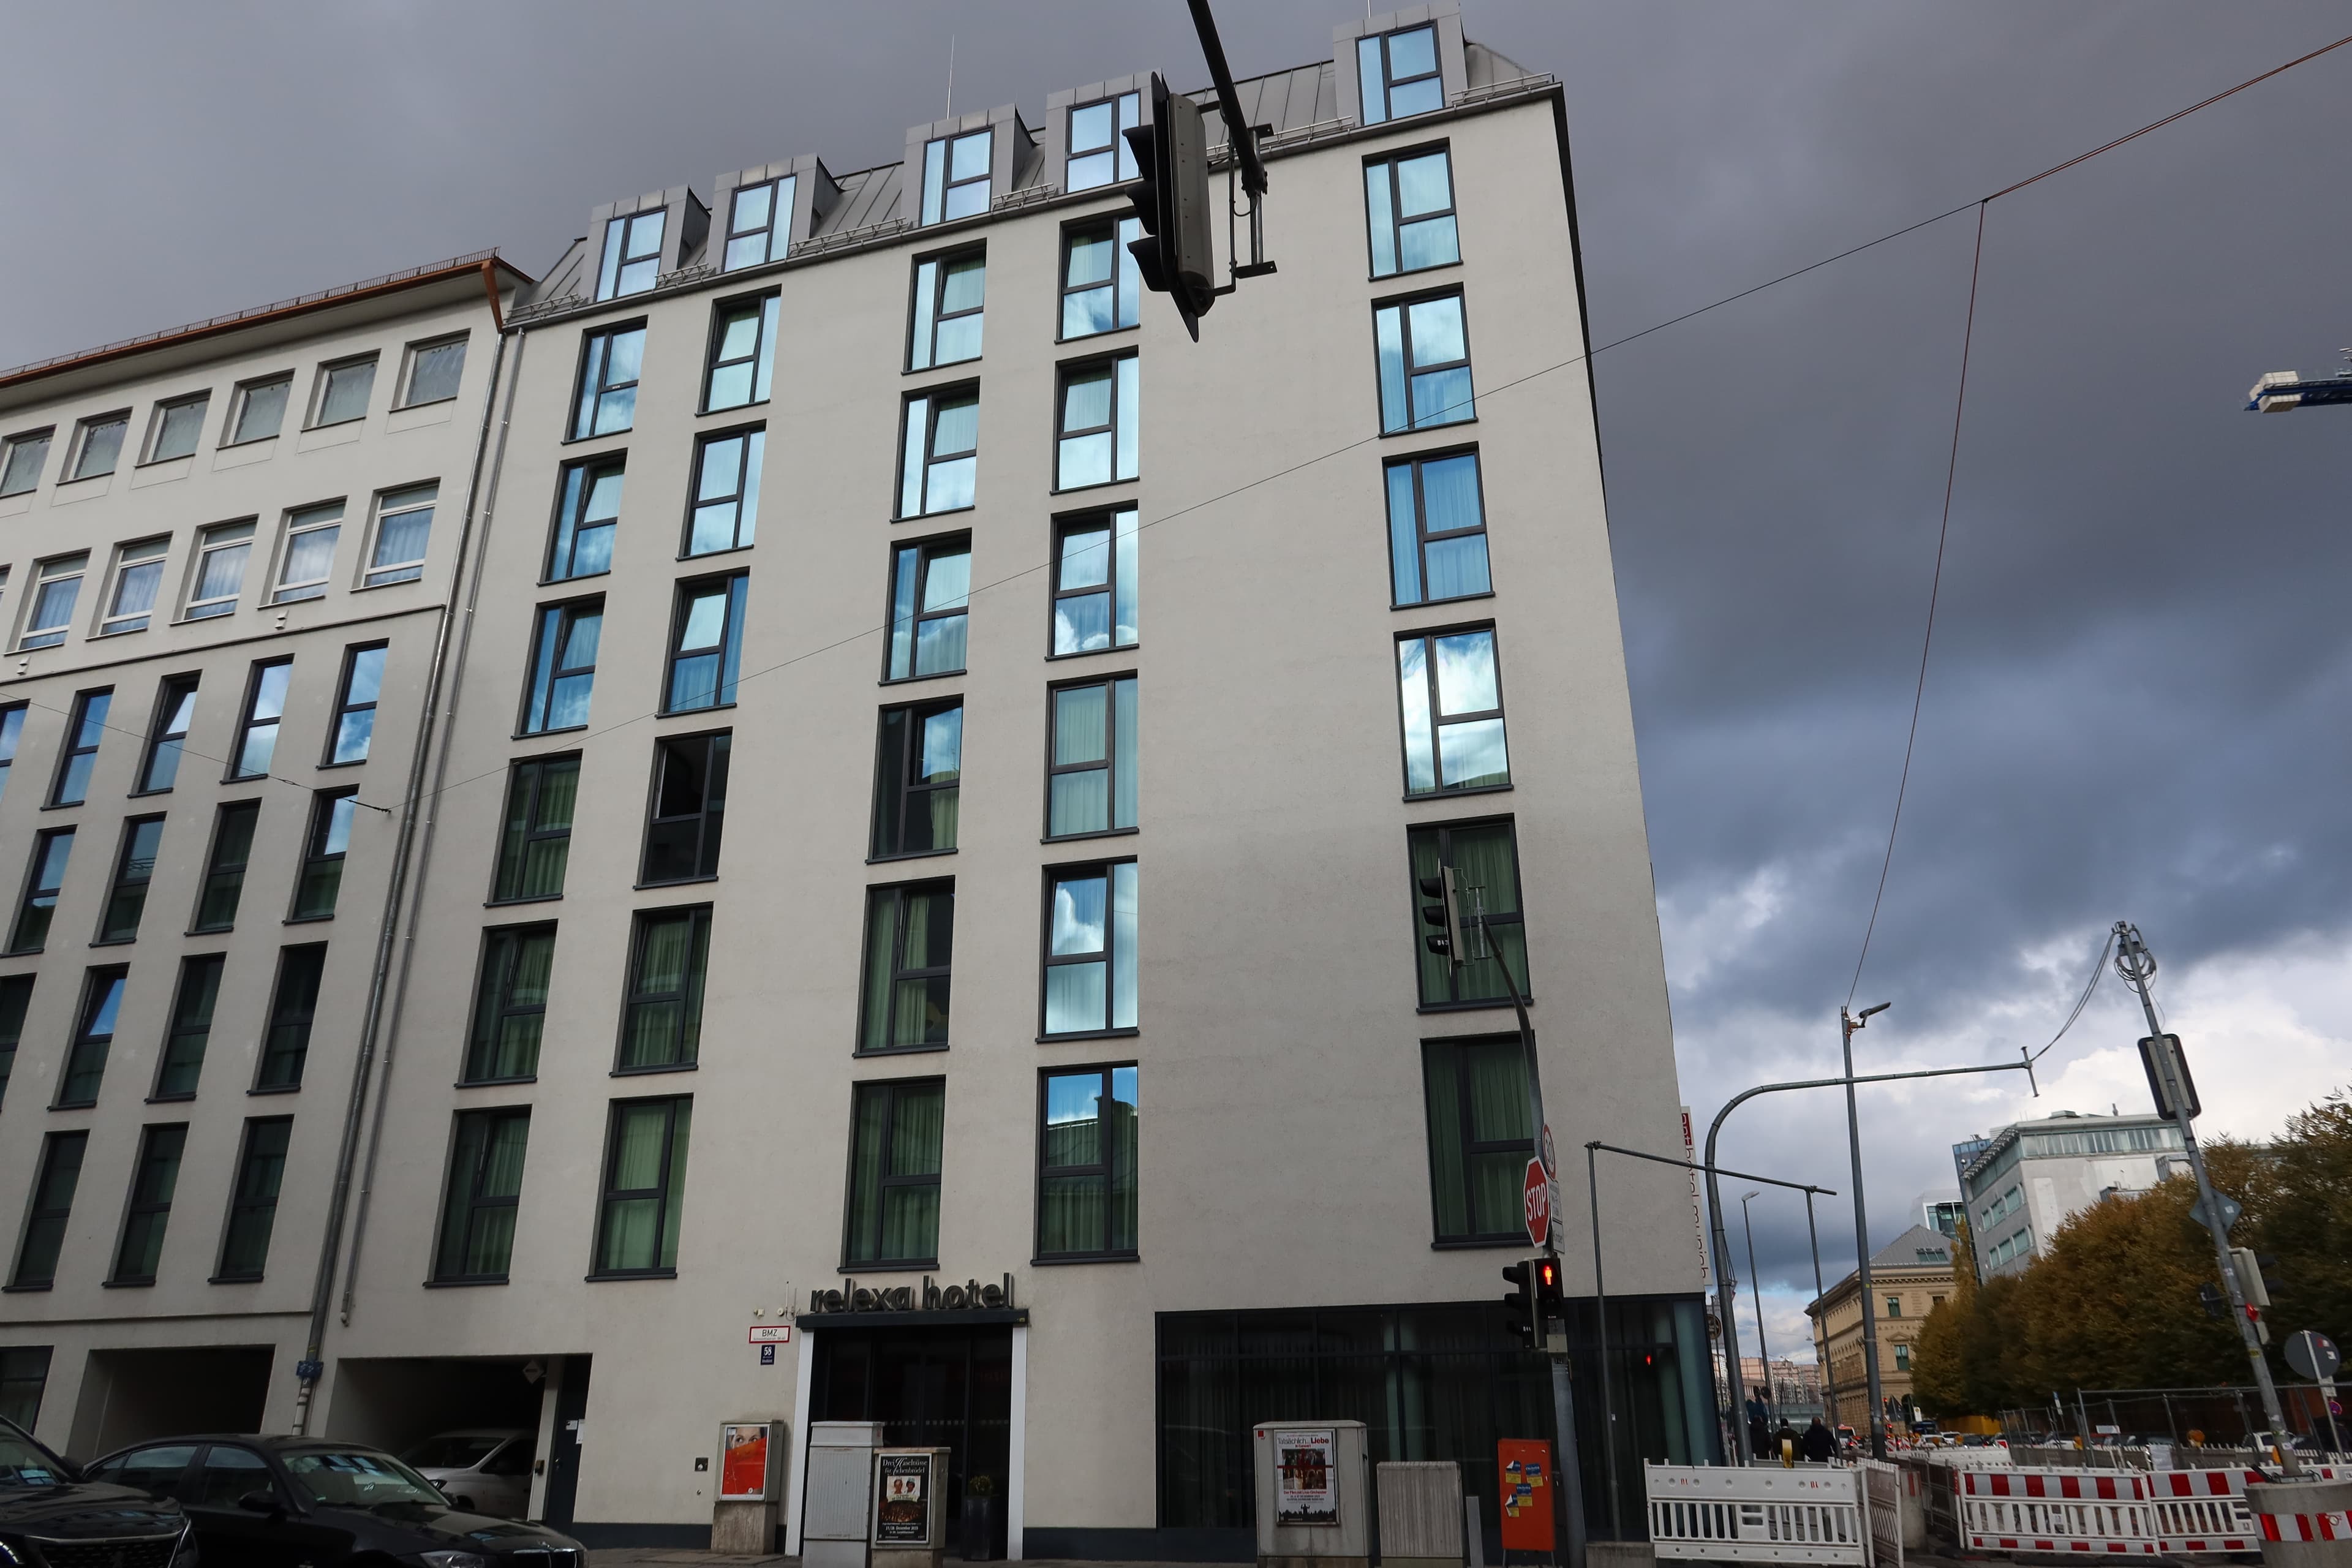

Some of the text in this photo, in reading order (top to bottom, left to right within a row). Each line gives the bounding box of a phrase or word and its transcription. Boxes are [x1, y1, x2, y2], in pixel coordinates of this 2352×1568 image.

[1526, 1182, 1547, 1221] STOP
[810, 1272, 1013, 1313] relexa hotel
[762, 1329, 778, 1337] BMZ
[764, 1346, 772, 1356] 58
